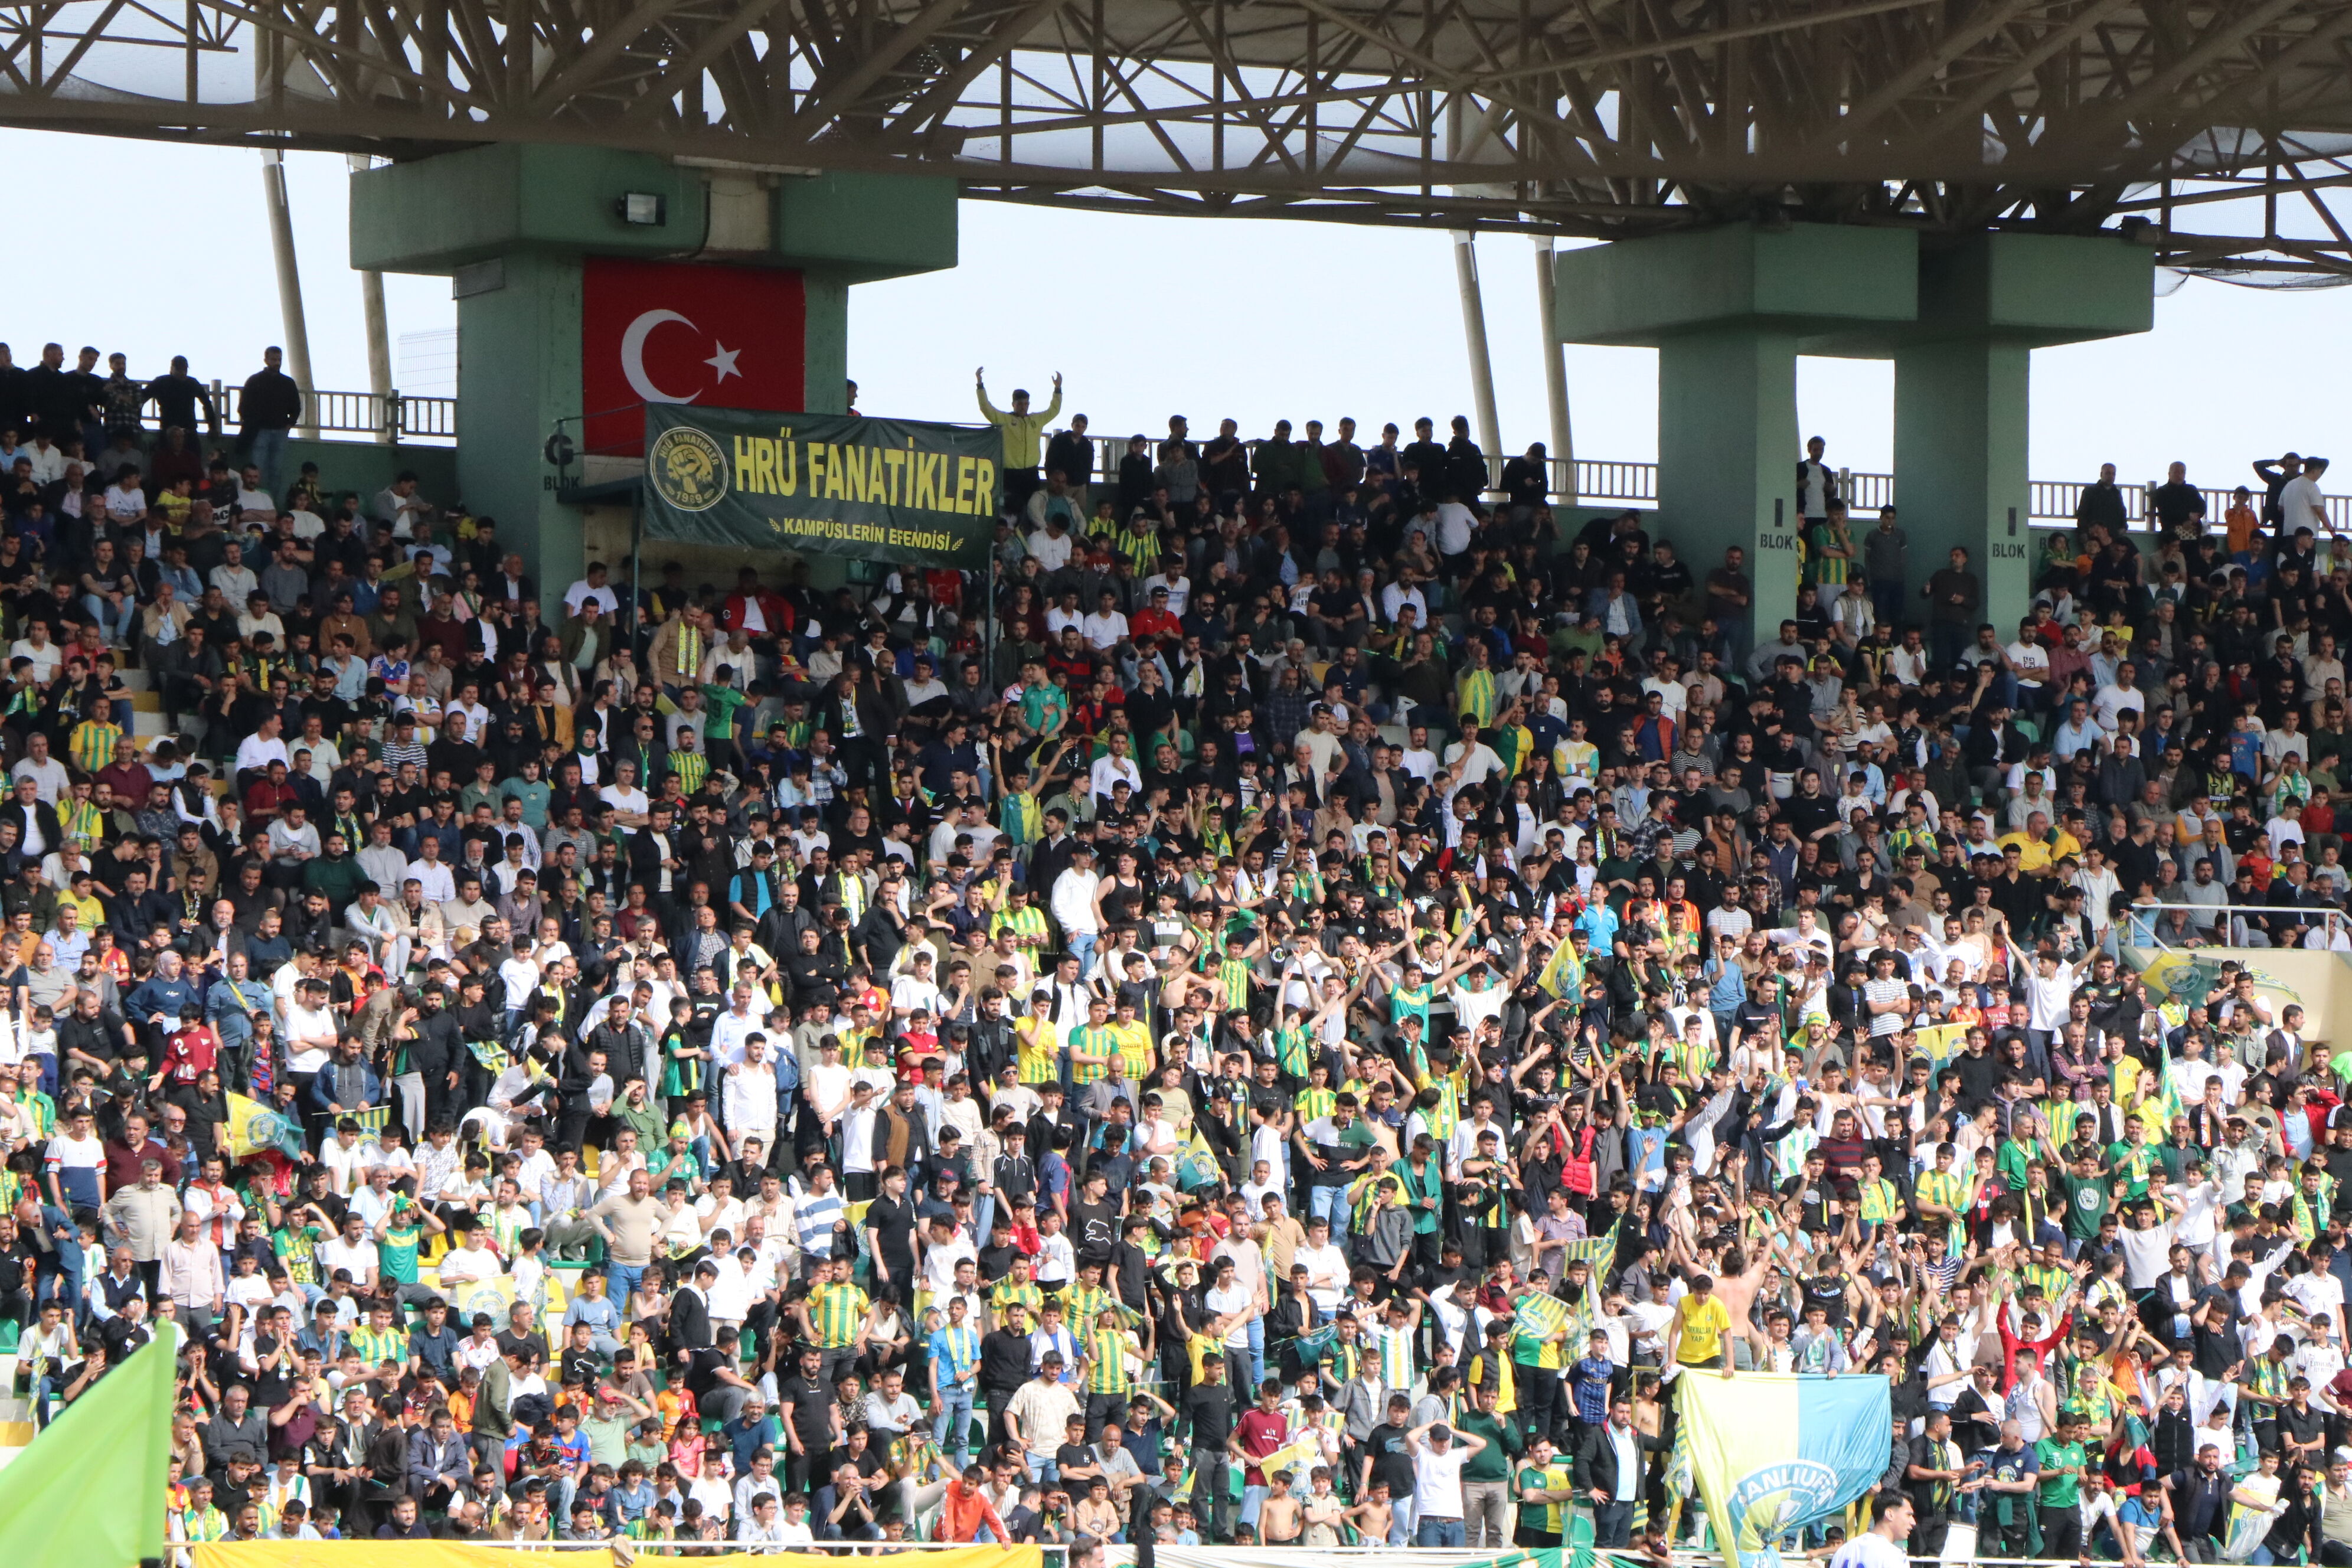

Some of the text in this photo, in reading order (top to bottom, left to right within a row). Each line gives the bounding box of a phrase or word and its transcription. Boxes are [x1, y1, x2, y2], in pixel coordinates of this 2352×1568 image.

[734, 427, 995, 517] HRÜ FANATİKLER
[784, 517, 950, 551] KAMPÜSLERİN EFENDİSİ
[1760, 534, 1793, 550] BLOK
[1992, 543, 2025, 558] BLOK
